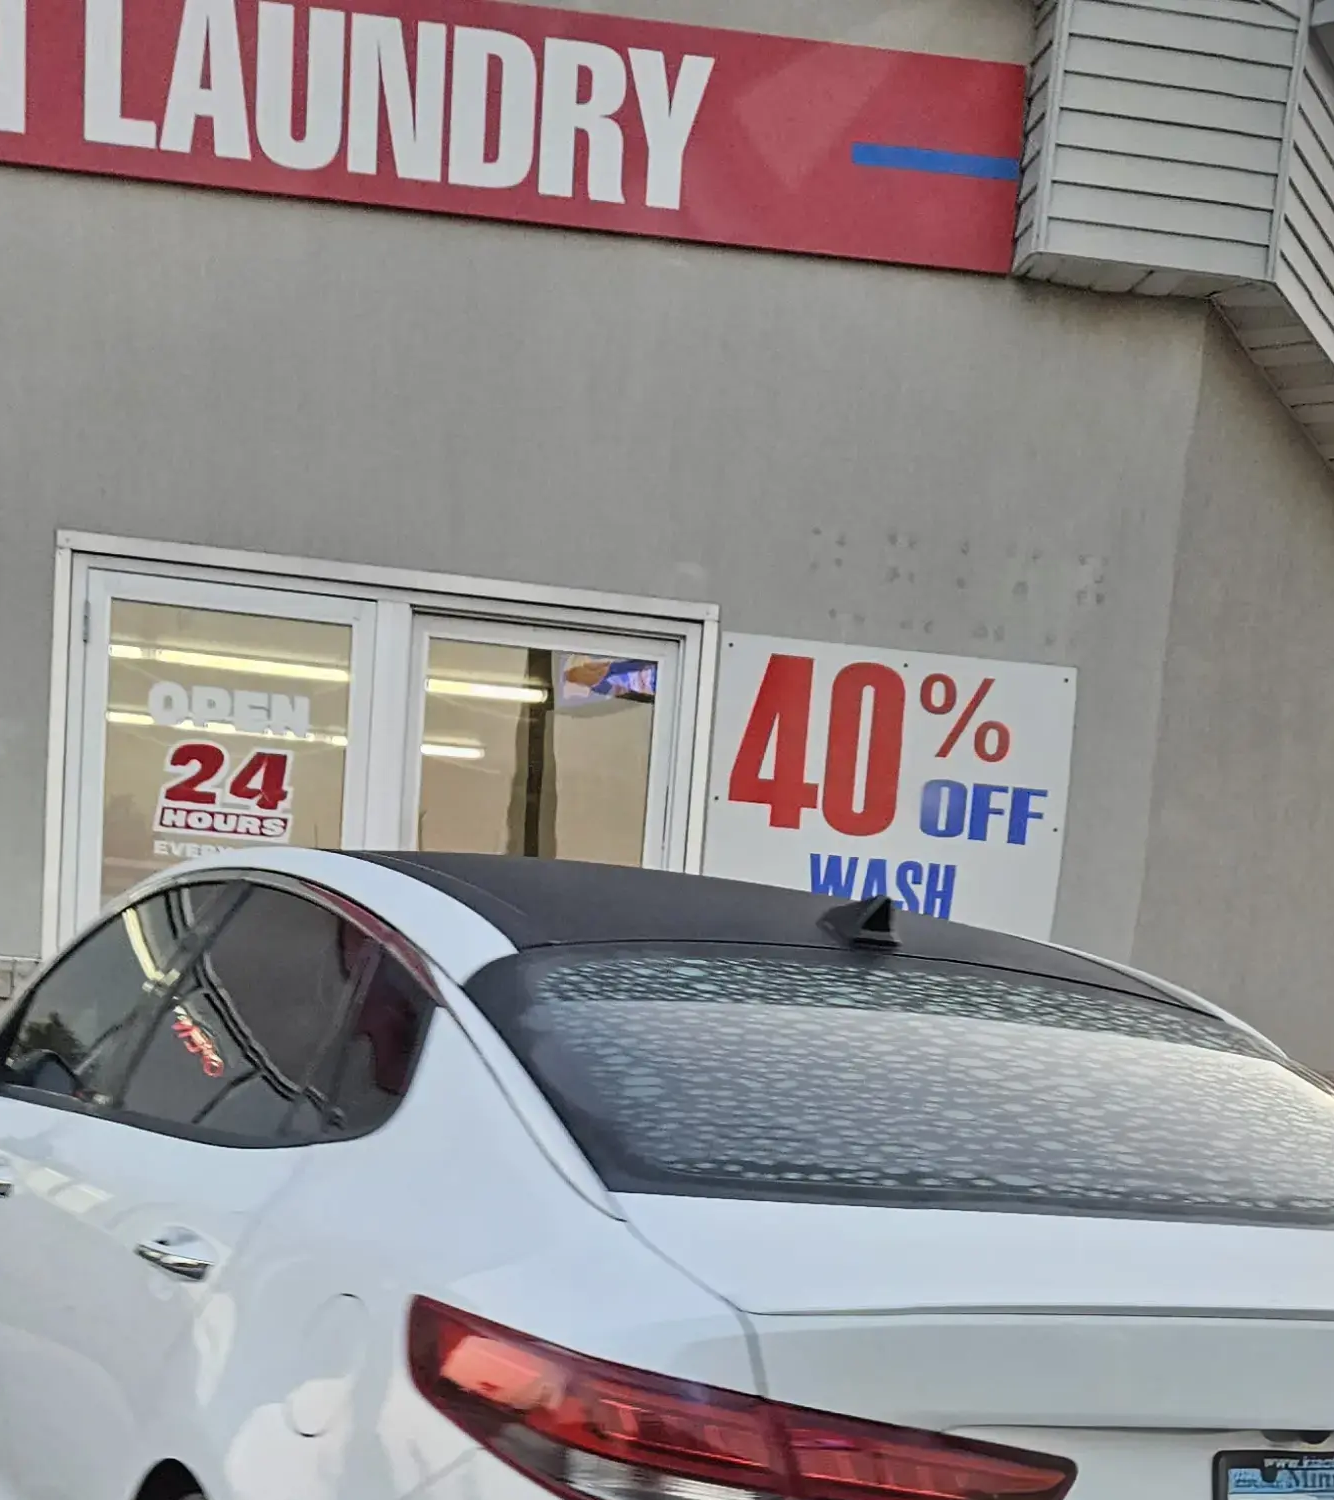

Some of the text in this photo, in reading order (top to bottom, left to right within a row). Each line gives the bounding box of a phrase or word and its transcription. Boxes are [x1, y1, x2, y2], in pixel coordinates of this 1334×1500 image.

[85, 0, 716, 211] LAUNDRY
[148, 680, 311, 738] OPEN
[164, 742, 288, 811] 24
[161, 808, 287, 837] HOURS
[919, 779, 1048, 845] OFF
[810, 853, 957, 920] WASH
